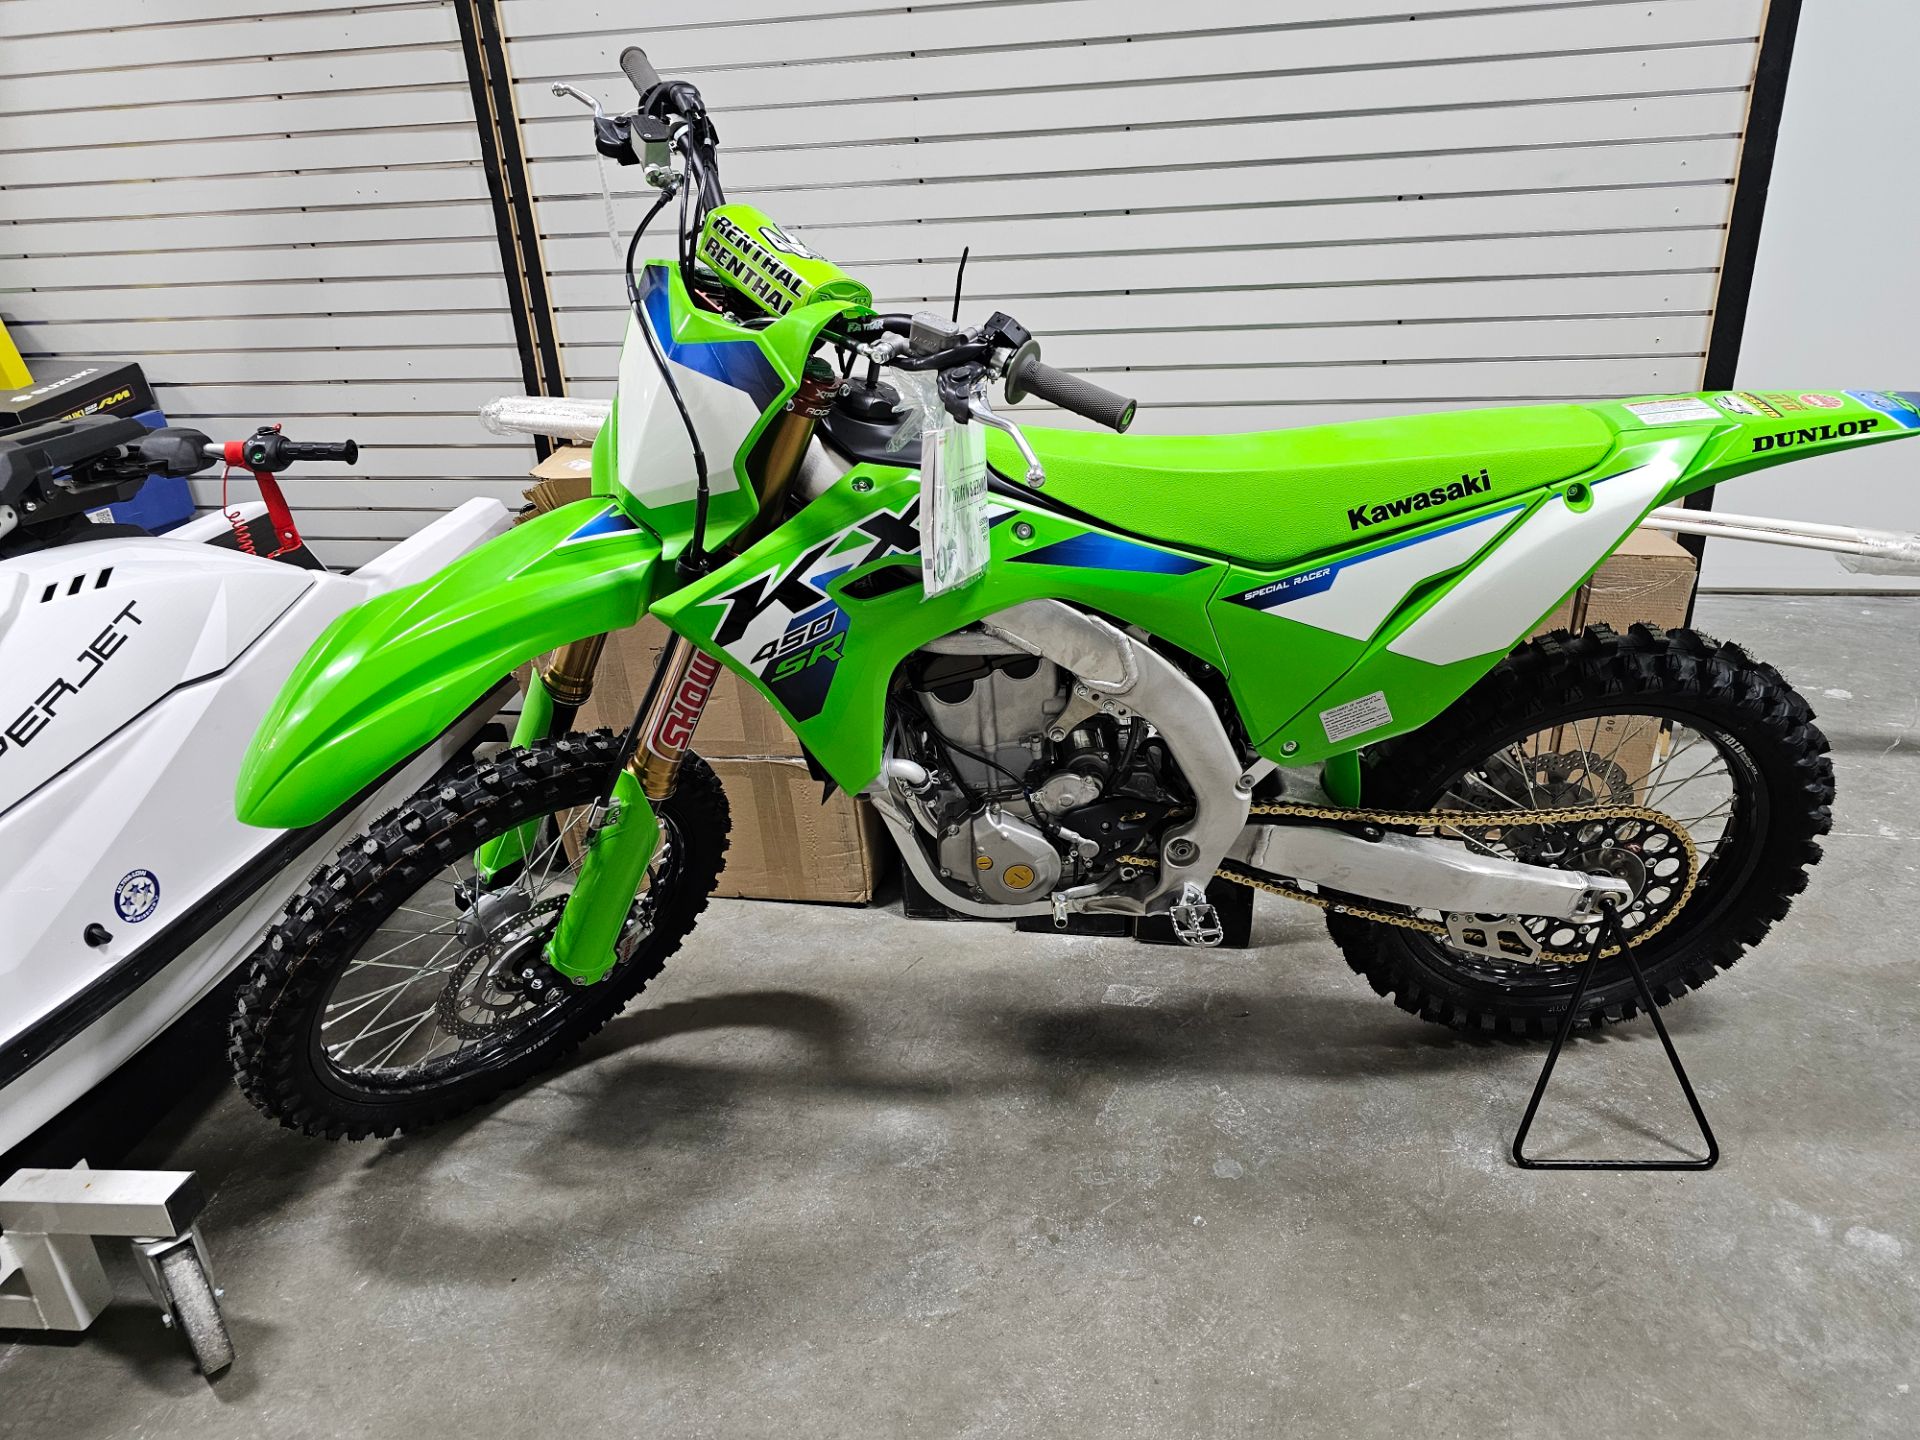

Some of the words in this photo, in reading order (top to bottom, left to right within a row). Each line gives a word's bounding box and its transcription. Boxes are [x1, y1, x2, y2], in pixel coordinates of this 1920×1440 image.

[711, 216, 805, 298] RENTHAL
[1751, 418, 1878, 453] DUNLOP
[1347, 468, 1492, 531] Kawasaki
[706, 495, 921, 648] KX
[1244, 581, 1290, 601] SPECIAL
[1293, 567, 1331, 586] RACER
[750, 607, 839, 665] 450
[770, 631, 845, 683] SR
[660, 648, 723, 752] SHOW
